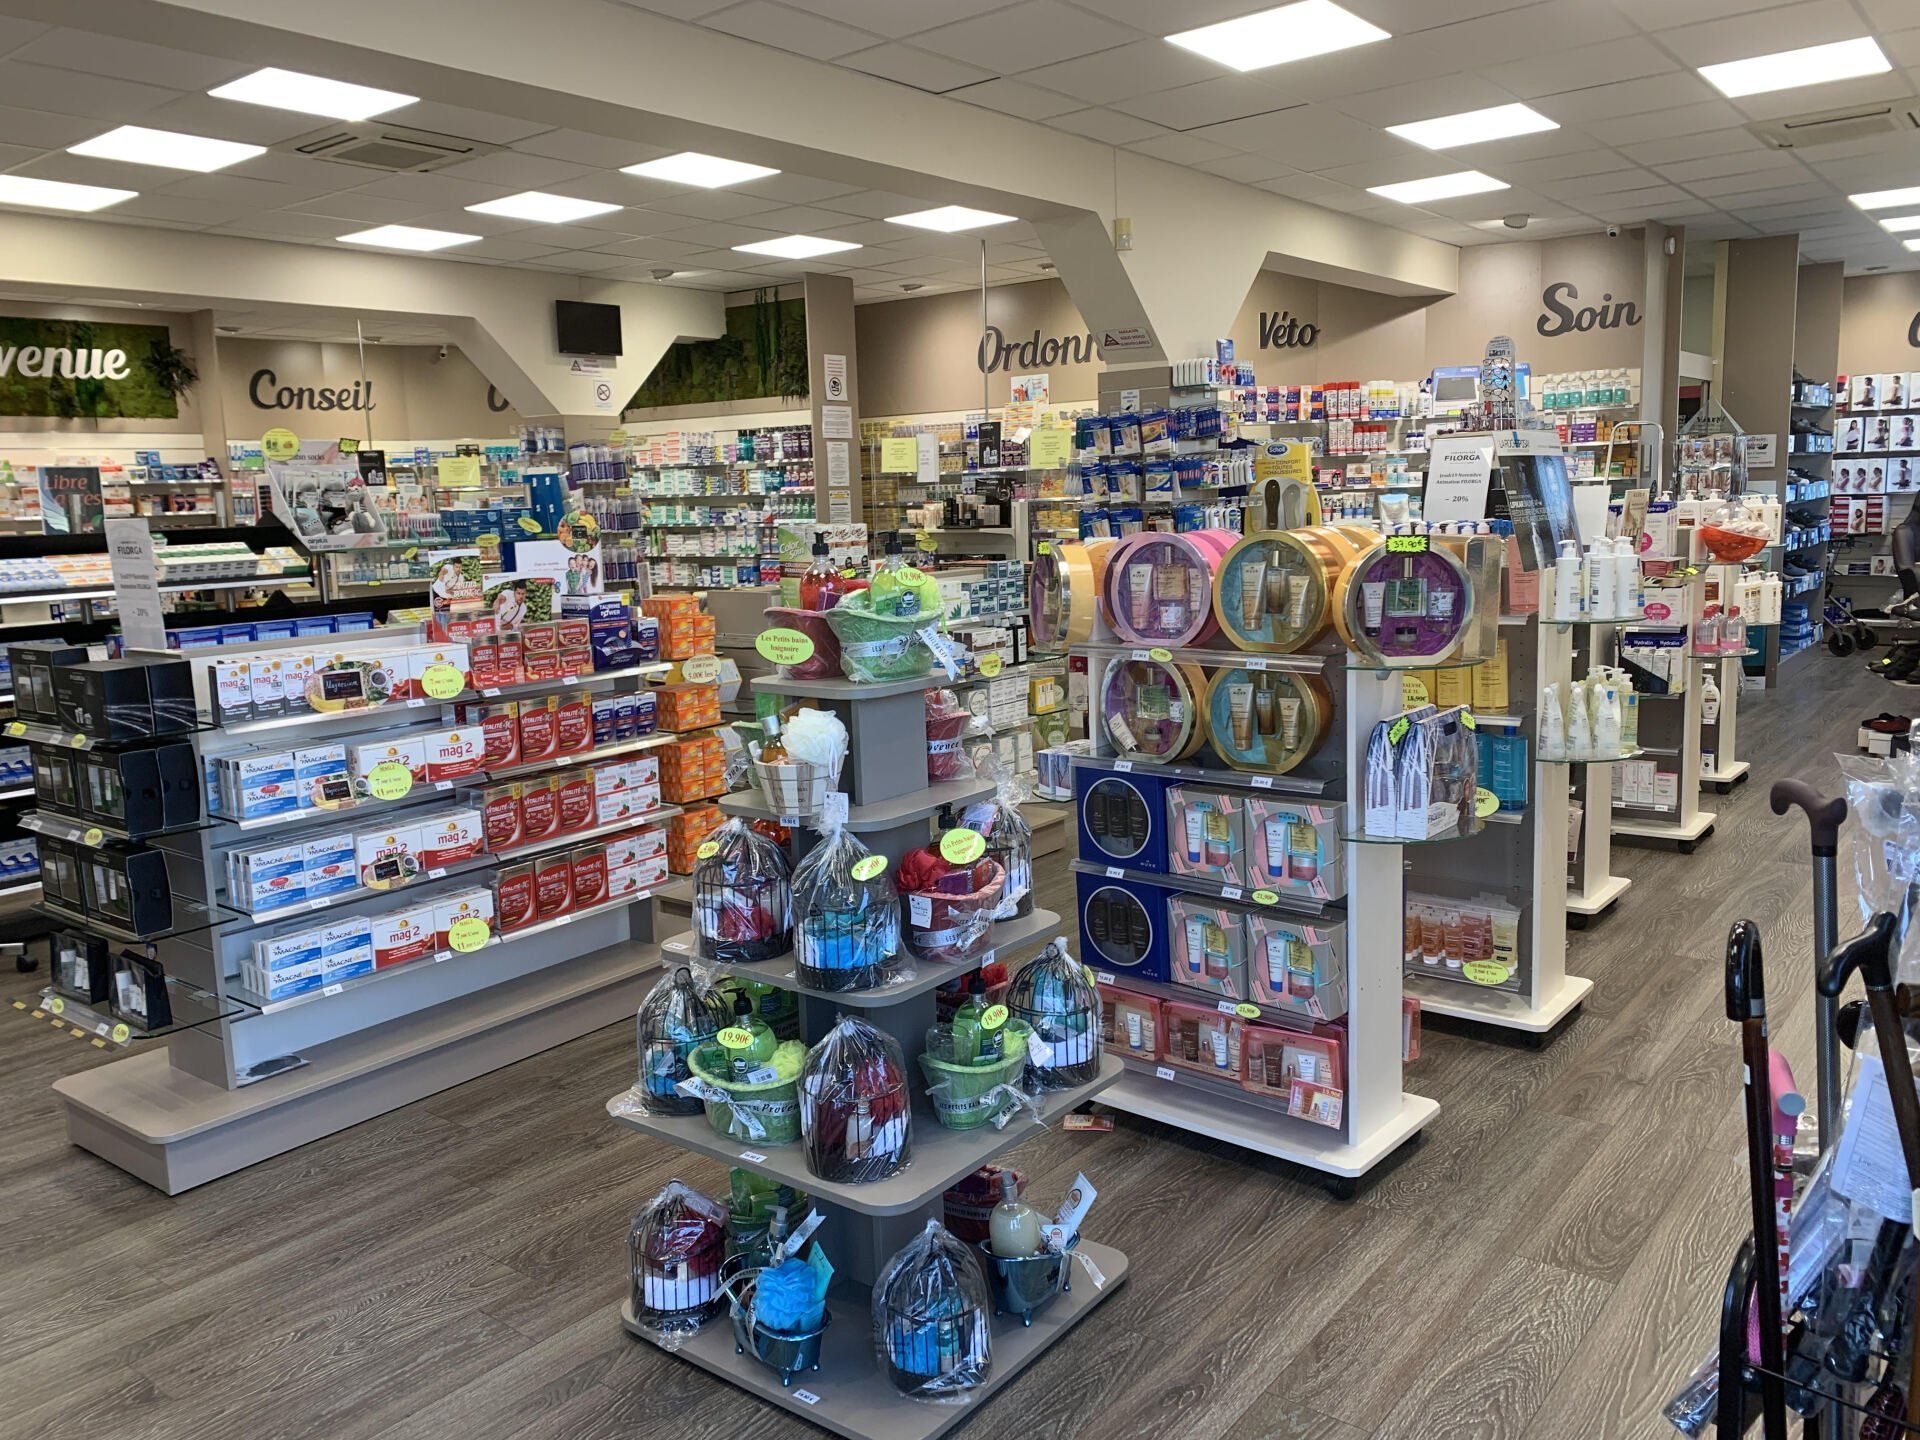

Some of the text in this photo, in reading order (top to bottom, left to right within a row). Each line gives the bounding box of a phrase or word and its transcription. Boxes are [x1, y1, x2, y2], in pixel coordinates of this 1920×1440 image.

[1537, 282, 1642, 338] Soin
[1259, 311, 1321, 350] Véto
[249, 368, 376, 412] Conseil
[1444, 454, 1481, 462] FILORGA
[44, 475, 88, 490] Libre
[773, 635, 790, 643] Petits
[253, 676, 271, 684] mag
[285, 670, 310, 680] mag 2
[220, 678, 246, 689] mag 2
[440, 742, 473, 758] mag 2
[402, 755, 410, 765] 2
[438, 829, 468, 845] mag 2
[400, 843, 408, 852] 2
[472, 909, 480, 919] 2
[390, 926, 420, 943] mag 2
